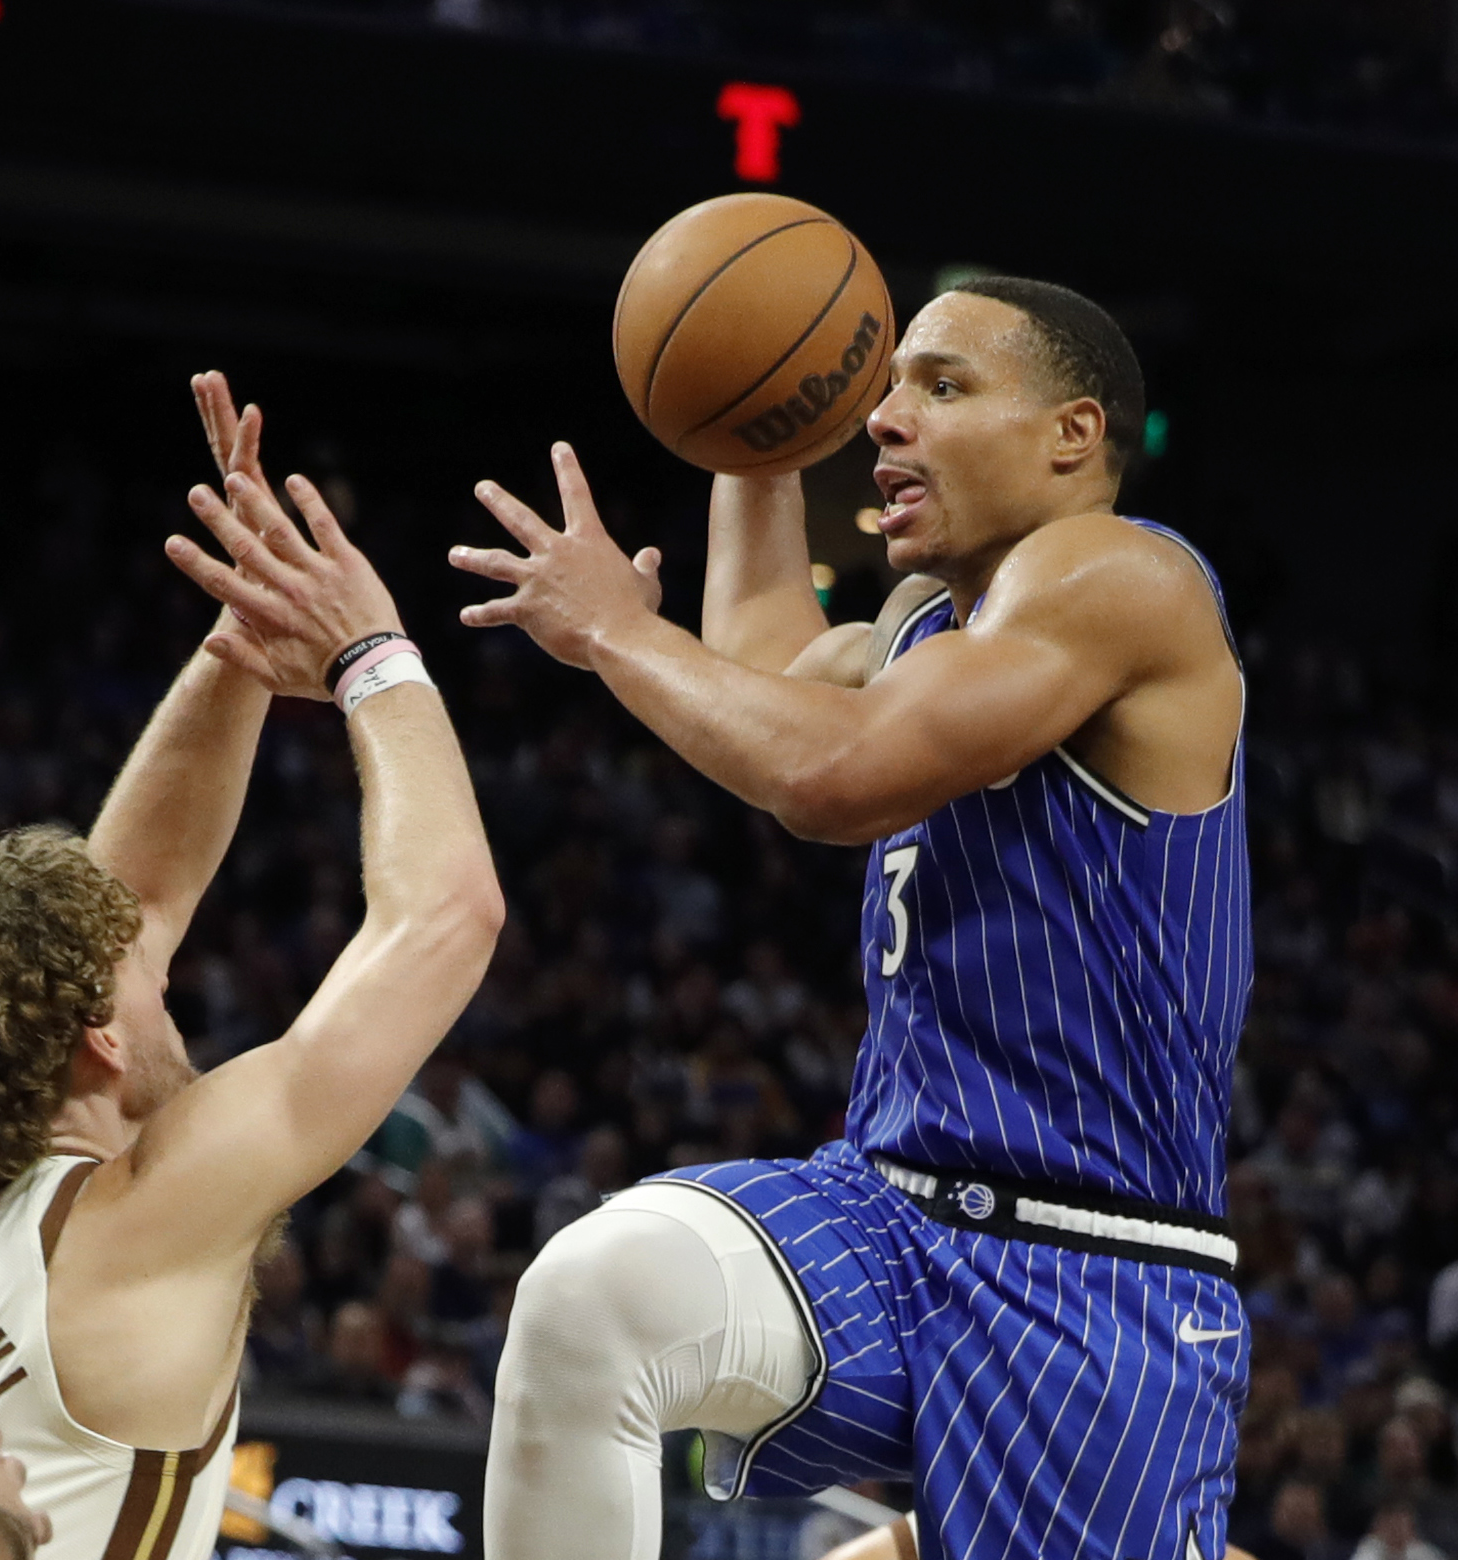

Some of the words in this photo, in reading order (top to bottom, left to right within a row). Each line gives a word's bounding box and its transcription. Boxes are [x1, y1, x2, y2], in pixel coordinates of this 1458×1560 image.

[731, 311, 882, 453] Wilson
[343, 641, 368, 660] trust
[880, 842, 919, 978] 3
[270, 1477, 467, 1554] CREEK
